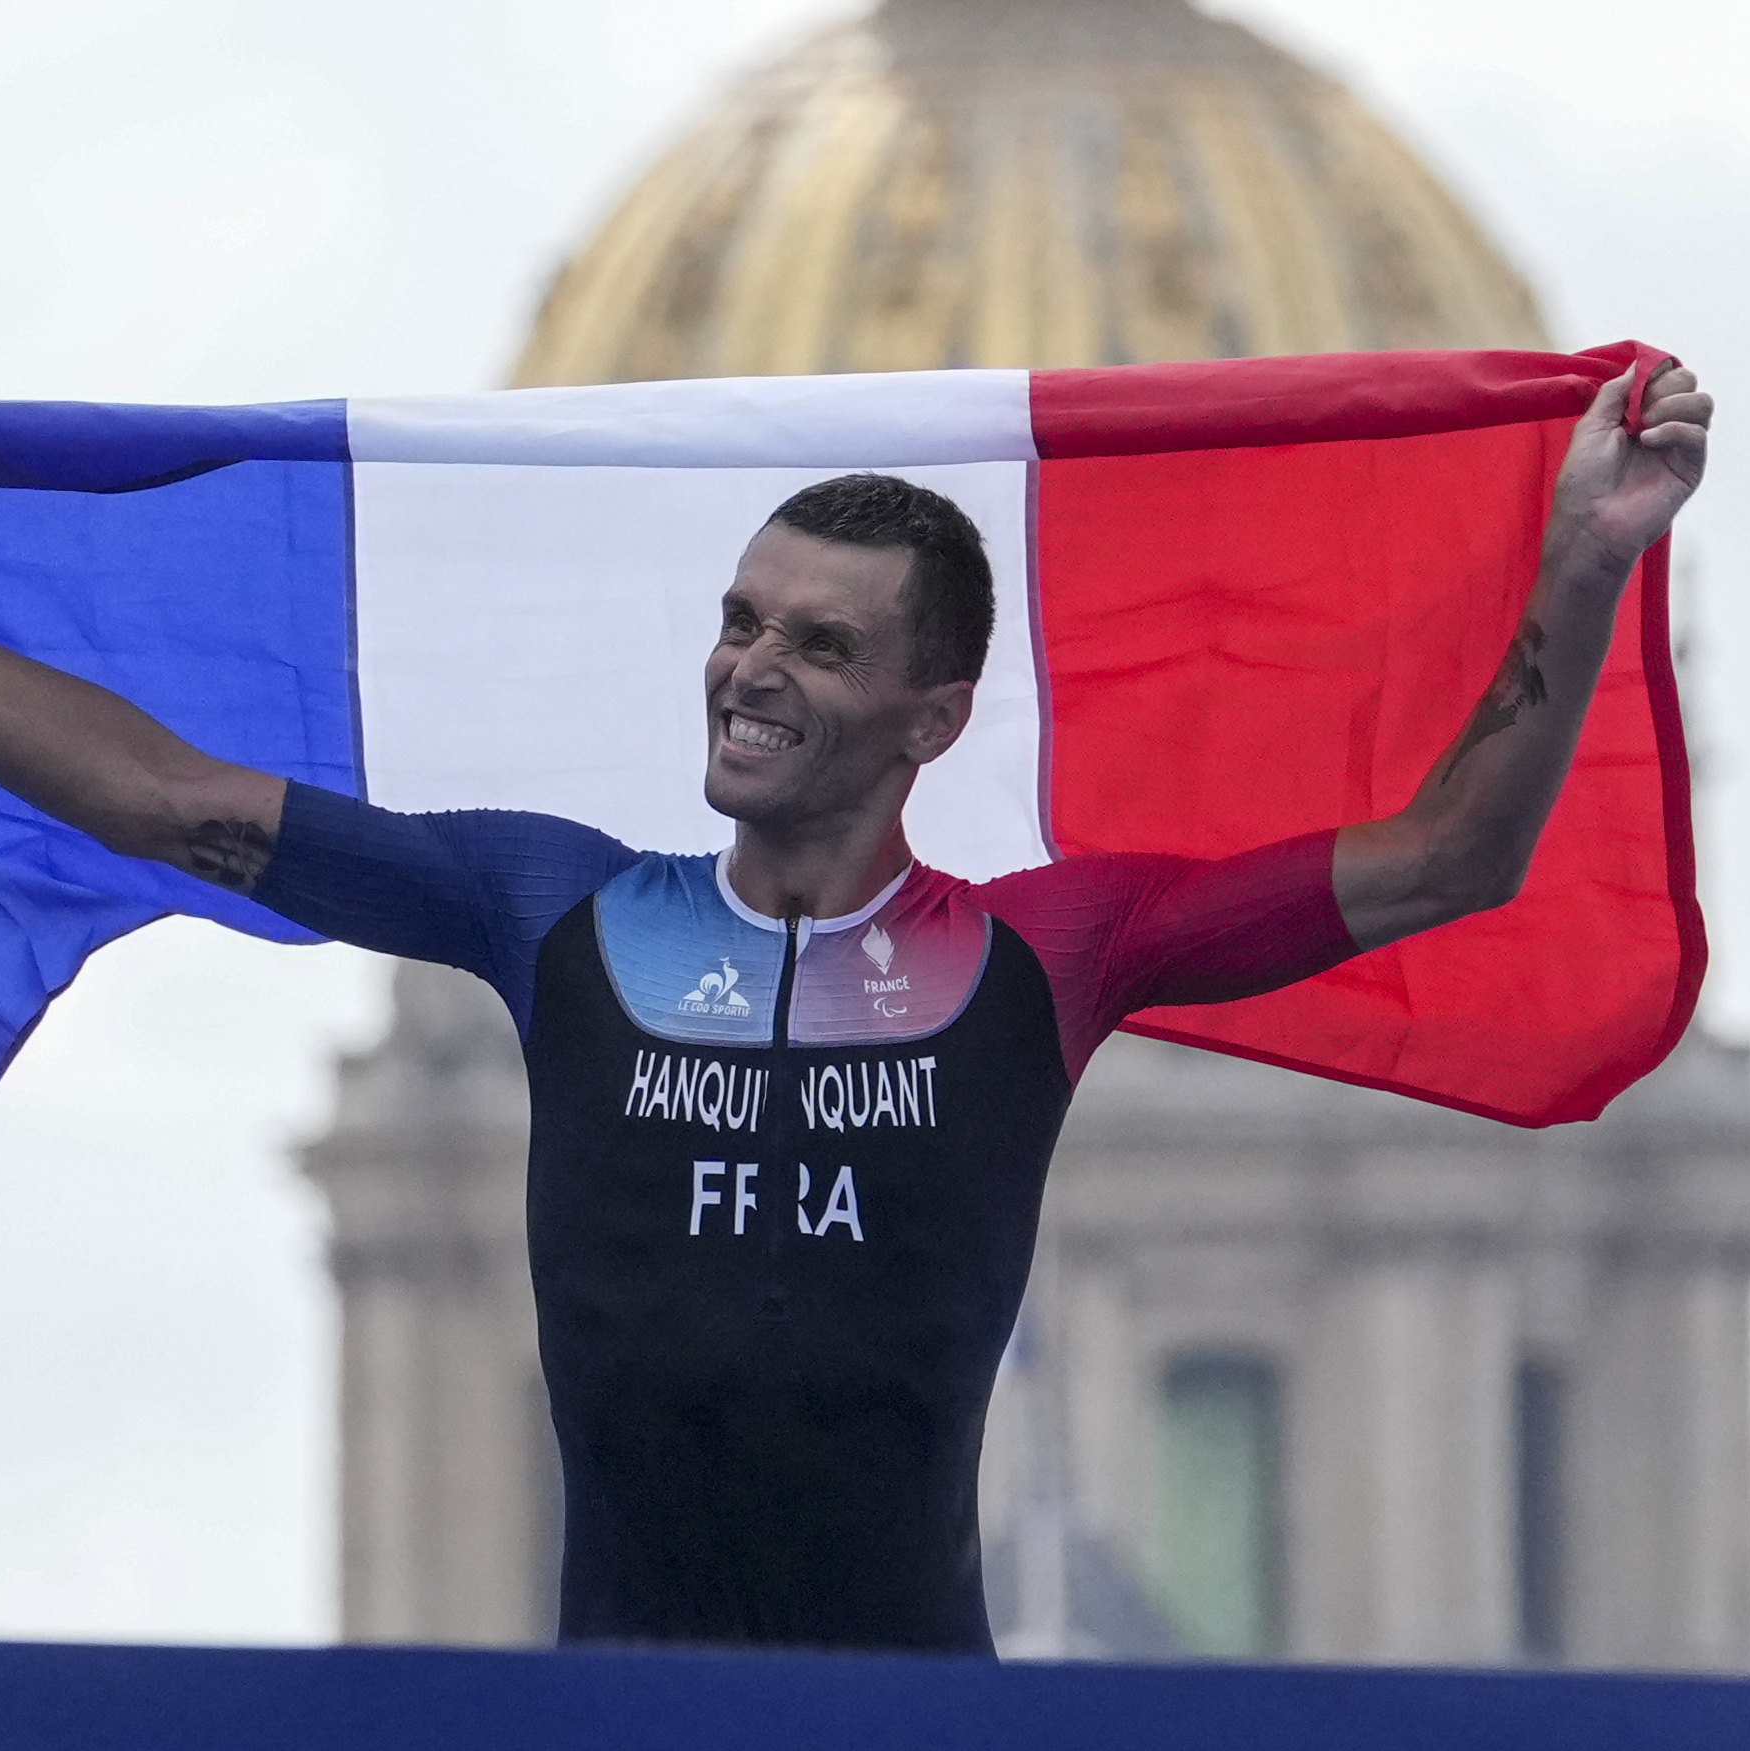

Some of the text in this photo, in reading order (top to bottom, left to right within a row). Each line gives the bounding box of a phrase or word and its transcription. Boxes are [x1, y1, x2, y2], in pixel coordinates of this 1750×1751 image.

[863, 975, 911, 994] FRANCE
[677, 1001, 690, 1012] LE
[711, 1004, 751, 1018] SPORTIF
